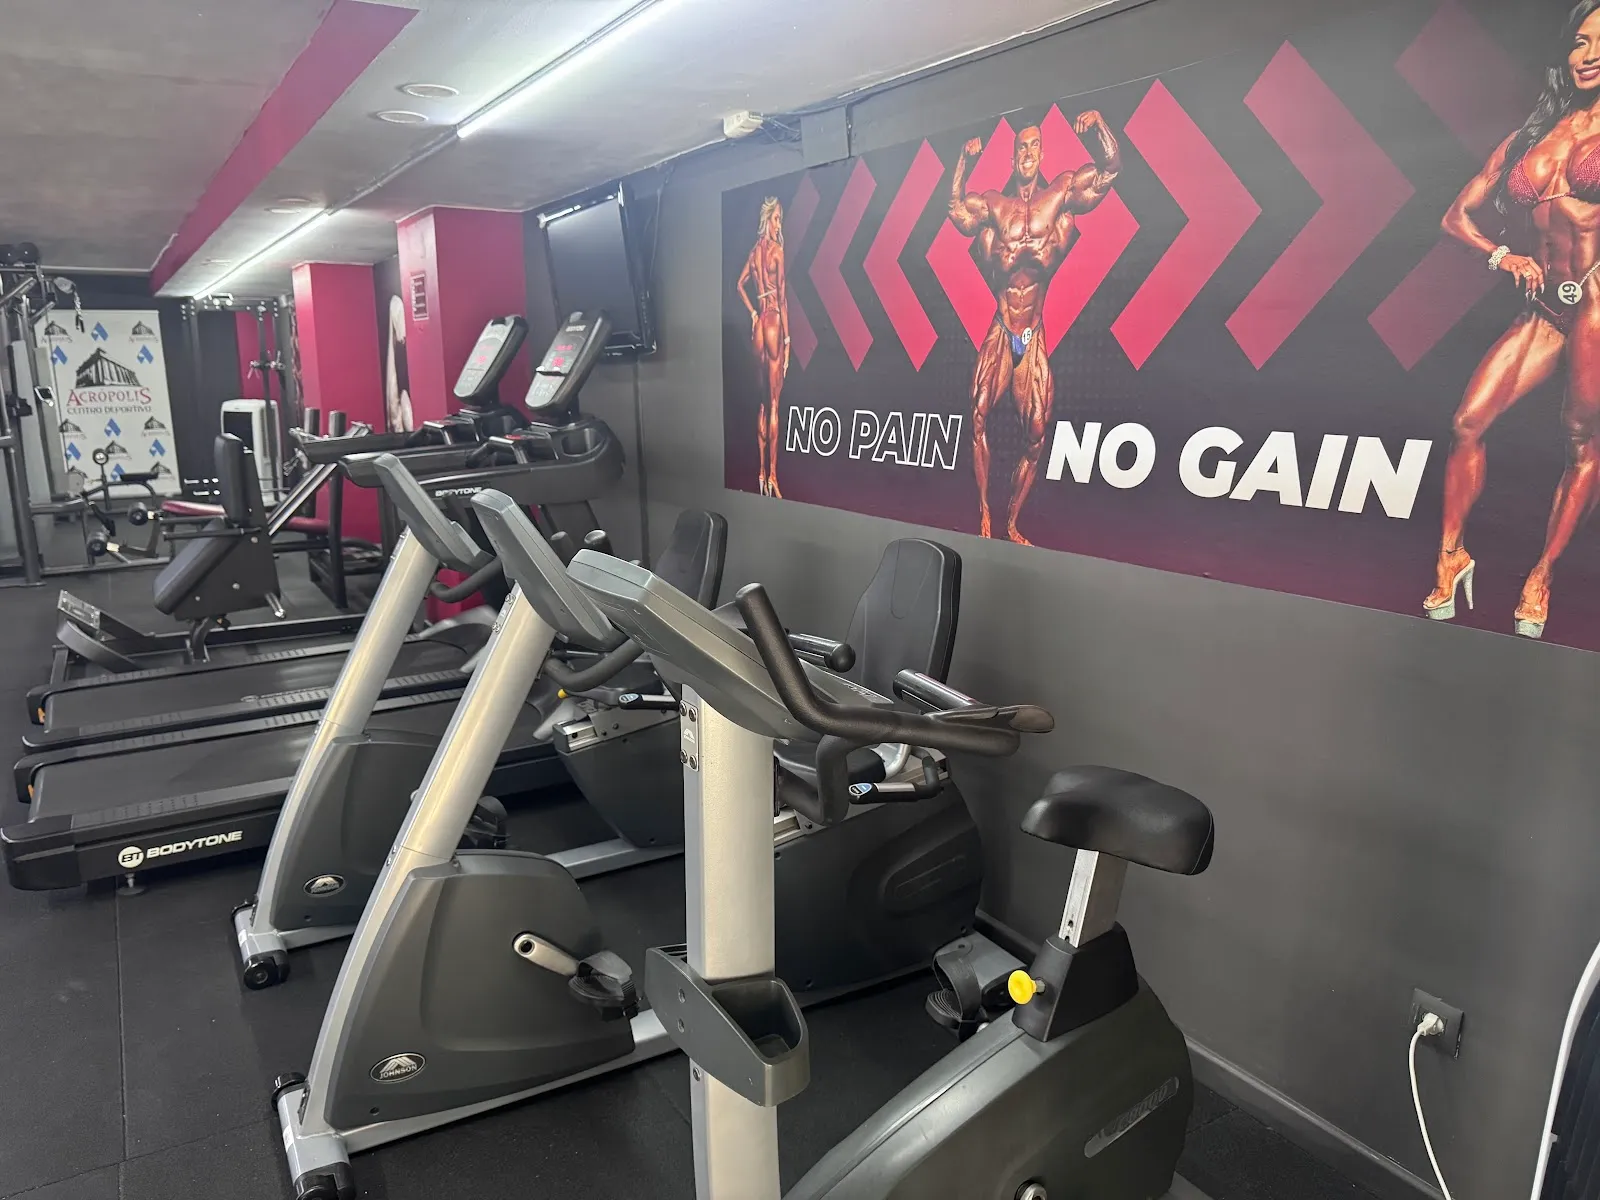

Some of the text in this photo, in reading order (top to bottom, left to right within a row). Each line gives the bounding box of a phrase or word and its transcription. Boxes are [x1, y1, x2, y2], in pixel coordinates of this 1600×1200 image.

[785, 406, 1433, 520] NO PAIN NO GAIN
[146, 830, 243, 859] BODYTONE
[379, 1063, 418, 1080] JOHNSON
